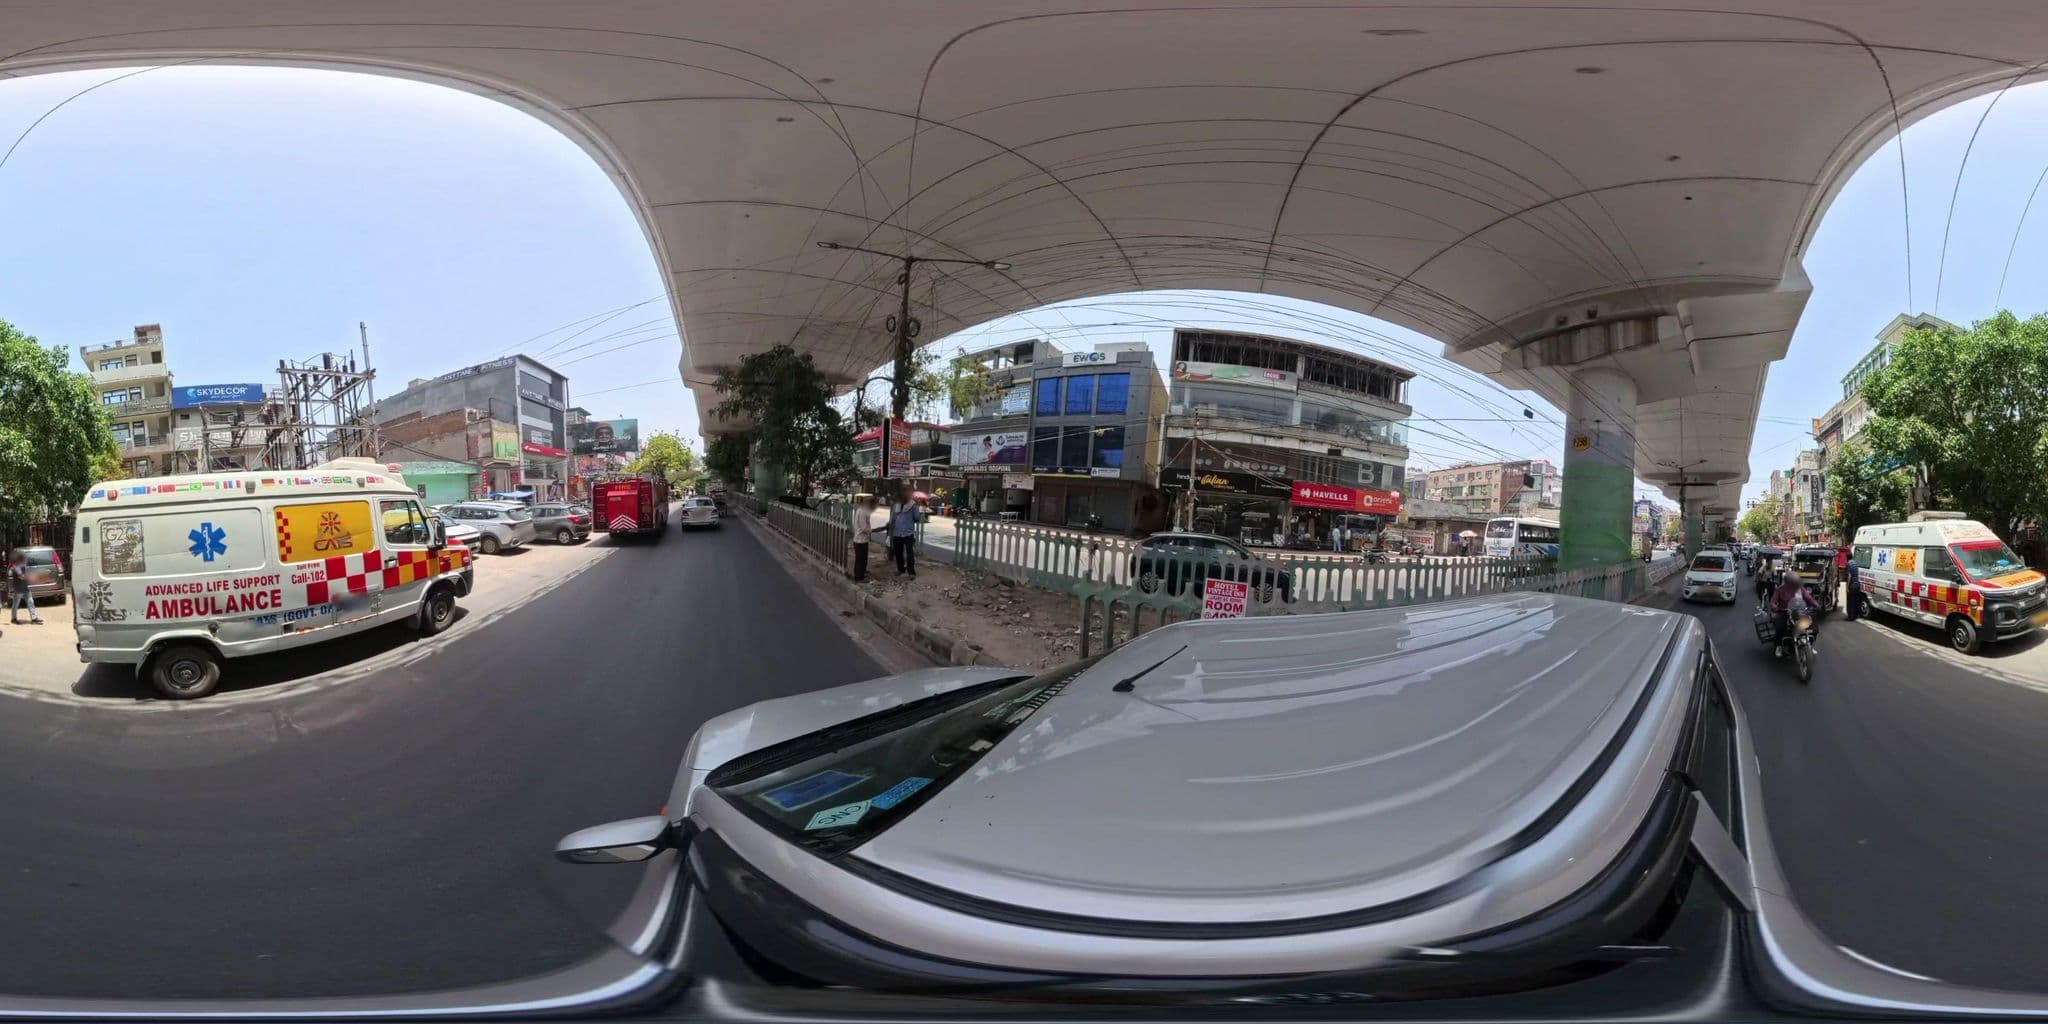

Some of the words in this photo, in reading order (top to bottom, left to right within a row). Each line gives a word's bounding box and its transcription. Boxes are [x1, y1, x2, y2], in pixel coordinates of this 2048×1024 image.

[196, 386, 248, 396] SKYDECOR
[1312, 490, 1348, 502] HAVELLS
[291, 570, 325, 585] Call-102
[145, 582, 203, 597] ADVANCED
[206, 580, 230, 593] LIFE
[233, 574, 280, 589] SUPPORT
[1214, 582, 1238, 590] HOTEL
[145, 589, 282, 620] AMBULANCE
[1205, 600, 1243, 613] ROOM
[818, 805, 862, 825] CNG
